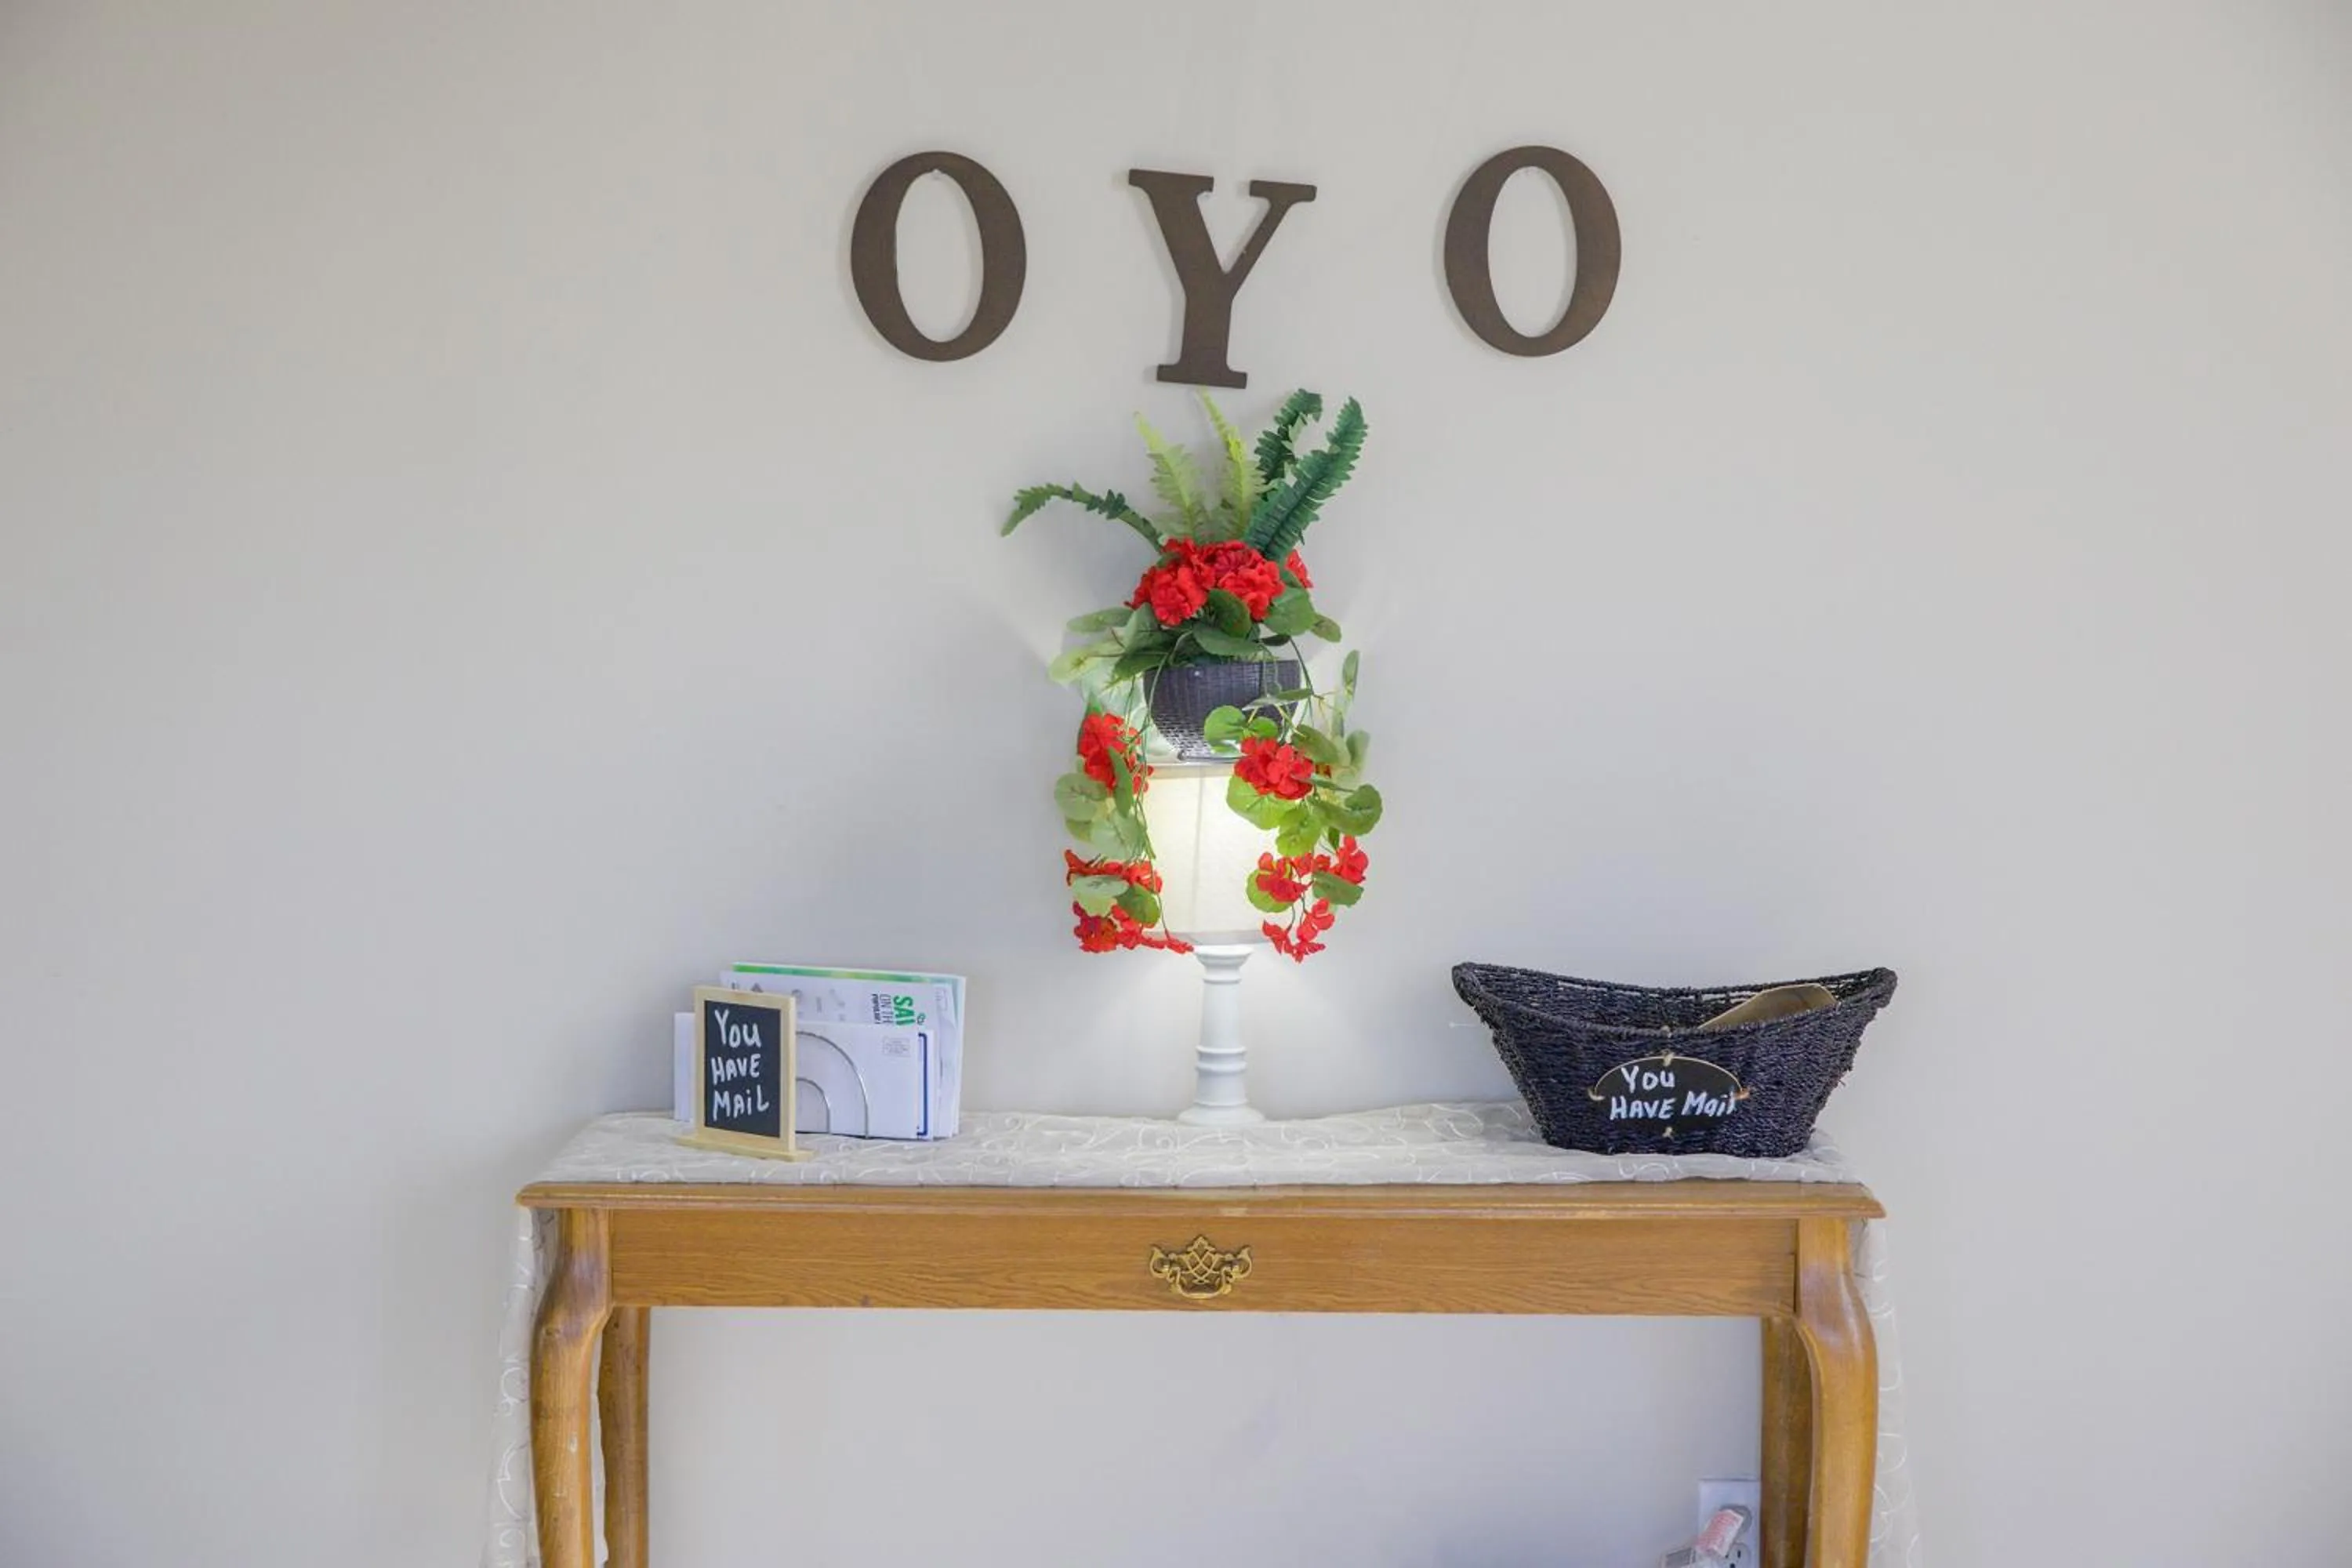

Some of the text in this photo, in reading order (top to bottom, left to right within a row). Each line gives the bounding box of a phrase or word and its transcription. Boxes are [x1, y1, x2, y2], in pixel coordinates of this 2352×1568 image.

[850, 144, 1622, 389] OYO
[714, 1008, 762, 1048] You
[710, 1053, 761, 1086] HAVE
[1621, 1065, 1675, 1094] You
[1610, 1090, 1736, 1120] HAVE Mail
